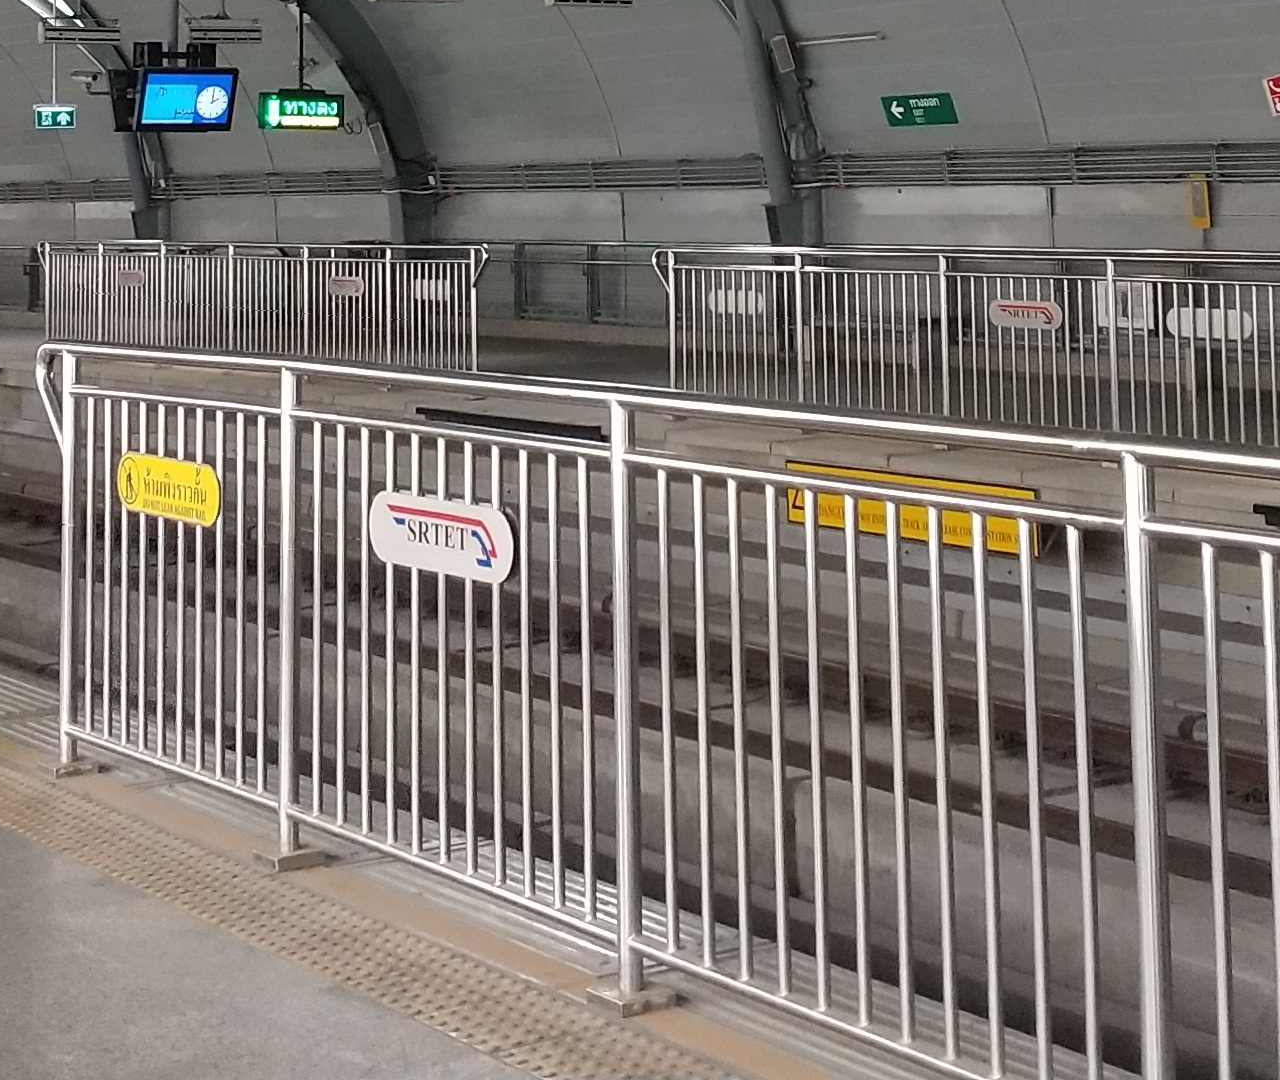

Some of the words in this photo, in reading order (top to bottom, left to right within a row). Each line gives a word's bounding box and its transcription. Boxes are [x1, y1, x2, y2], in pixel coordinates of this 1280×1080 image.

[283, 100, 338, 115] ทางลง
[143, 467, 207, 506] ห้ามพิงราวกั้น
[407, 518, 469, 551] SRTET
